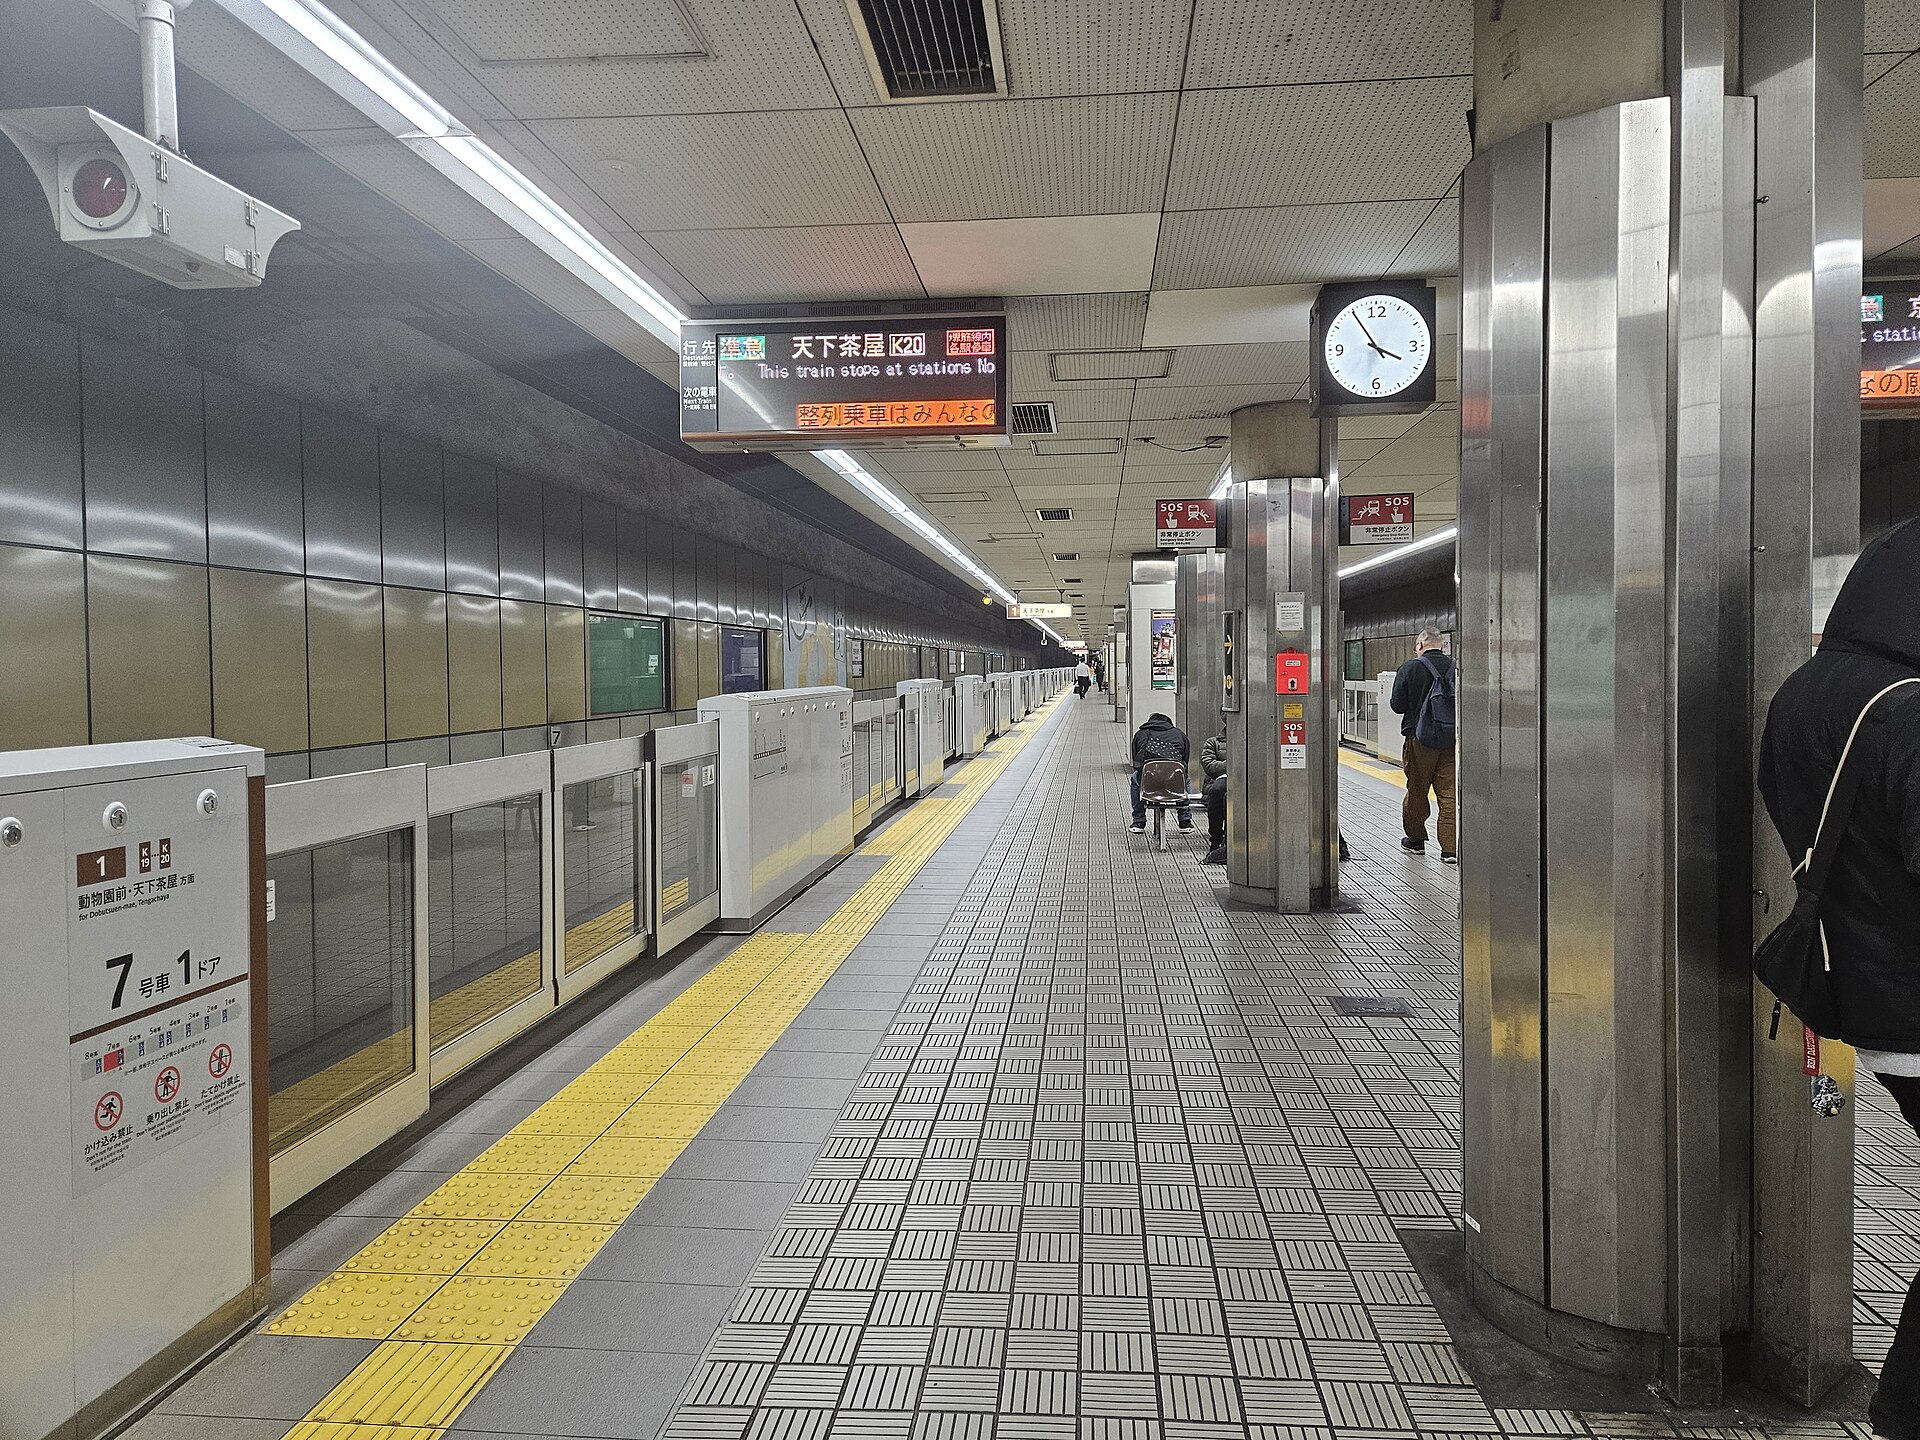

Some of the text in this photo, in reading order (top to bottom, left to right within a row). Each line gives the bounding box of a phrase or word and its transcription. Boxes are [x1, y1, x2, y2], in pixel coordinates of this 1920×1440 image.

[1368, 306, 1386, 318] 12
[792, 334, 922, 359] 天下茶屋 K20
[1335, 344, 1344, 356] 9
[1409, 340, 1418, 352] 3
[757, 363, 789, 378] This
[797, 364, 834, 378] train
[841, 364, 880, 377] stops
[886, 362, 902, 376] at
[909, 361, 972, 375] stations
[1372, 378, 1380, 390] 6
[1161, 503, 1183, 511] SOS
[1385, 497, 1409, 506] SOS
[1012, 607, 1017, 616] 1
[552, 731, 561, 744] 7
[142, 848, 148, 856] K
[162, 844, 168, 852] K
[141, 858, 149, 867] 19
[161, 854, 169, 863] 20
[96, 856, 105, 876] 1
[180, 873, 195, 885] 方面
[79, 893, 169, 921] for Dobutsuen-mae, Tengachaya
[200, 1073, 241, 1099] たてかけ禁止
[146, 1097, 189, 1125] 乗り出し禁止
[84, 1124, 133, 1155] かけ込み禁止
